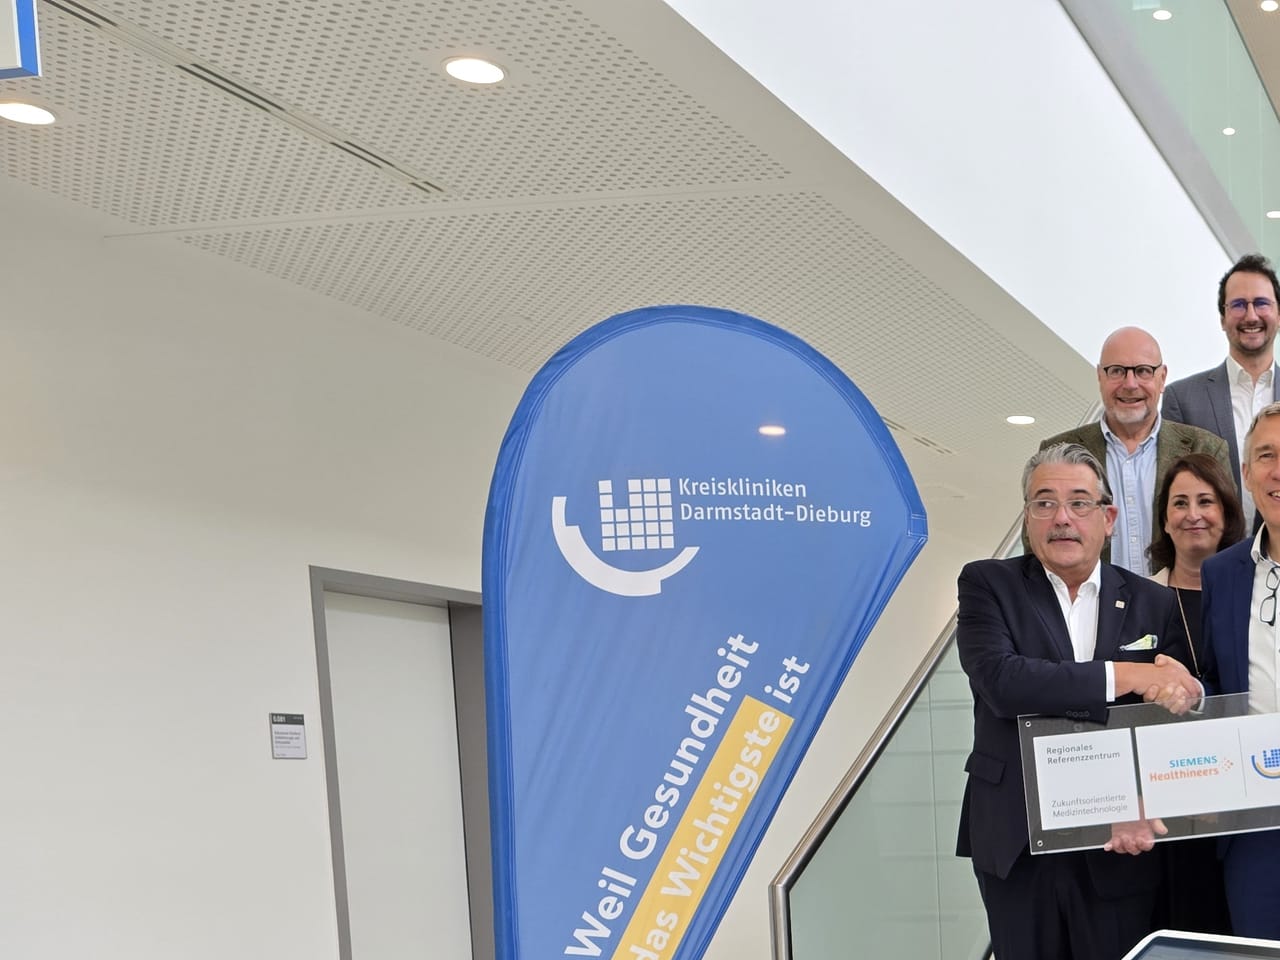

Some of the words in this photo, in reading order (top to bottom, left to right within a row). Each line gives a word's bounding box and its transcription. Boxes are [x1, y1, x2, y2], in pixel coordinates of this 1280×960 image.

[679, 477, 807, 498] Kreiskliniken
[680, 503, 871, 527] Darmstadt-Dieburg
[1046, 743, 1093, 756] Regionales
[1047, 751, 1121, 765] Referenzzentrum
[1169, 755, 1218, 769] SIEMENS
[660, 710, 781, 898] Wichtigste
[764, 655, 811, 704] ist
[1149, 766, 1220, 783] Healthineers
[564, 866, 638, 957] Weil
[619, 633, 760, 860] Gesundheit
[1051, 793, 1127, 808] Zukunftsorientierte
[1052, 803, 1129, 818] Medizintechnologie
